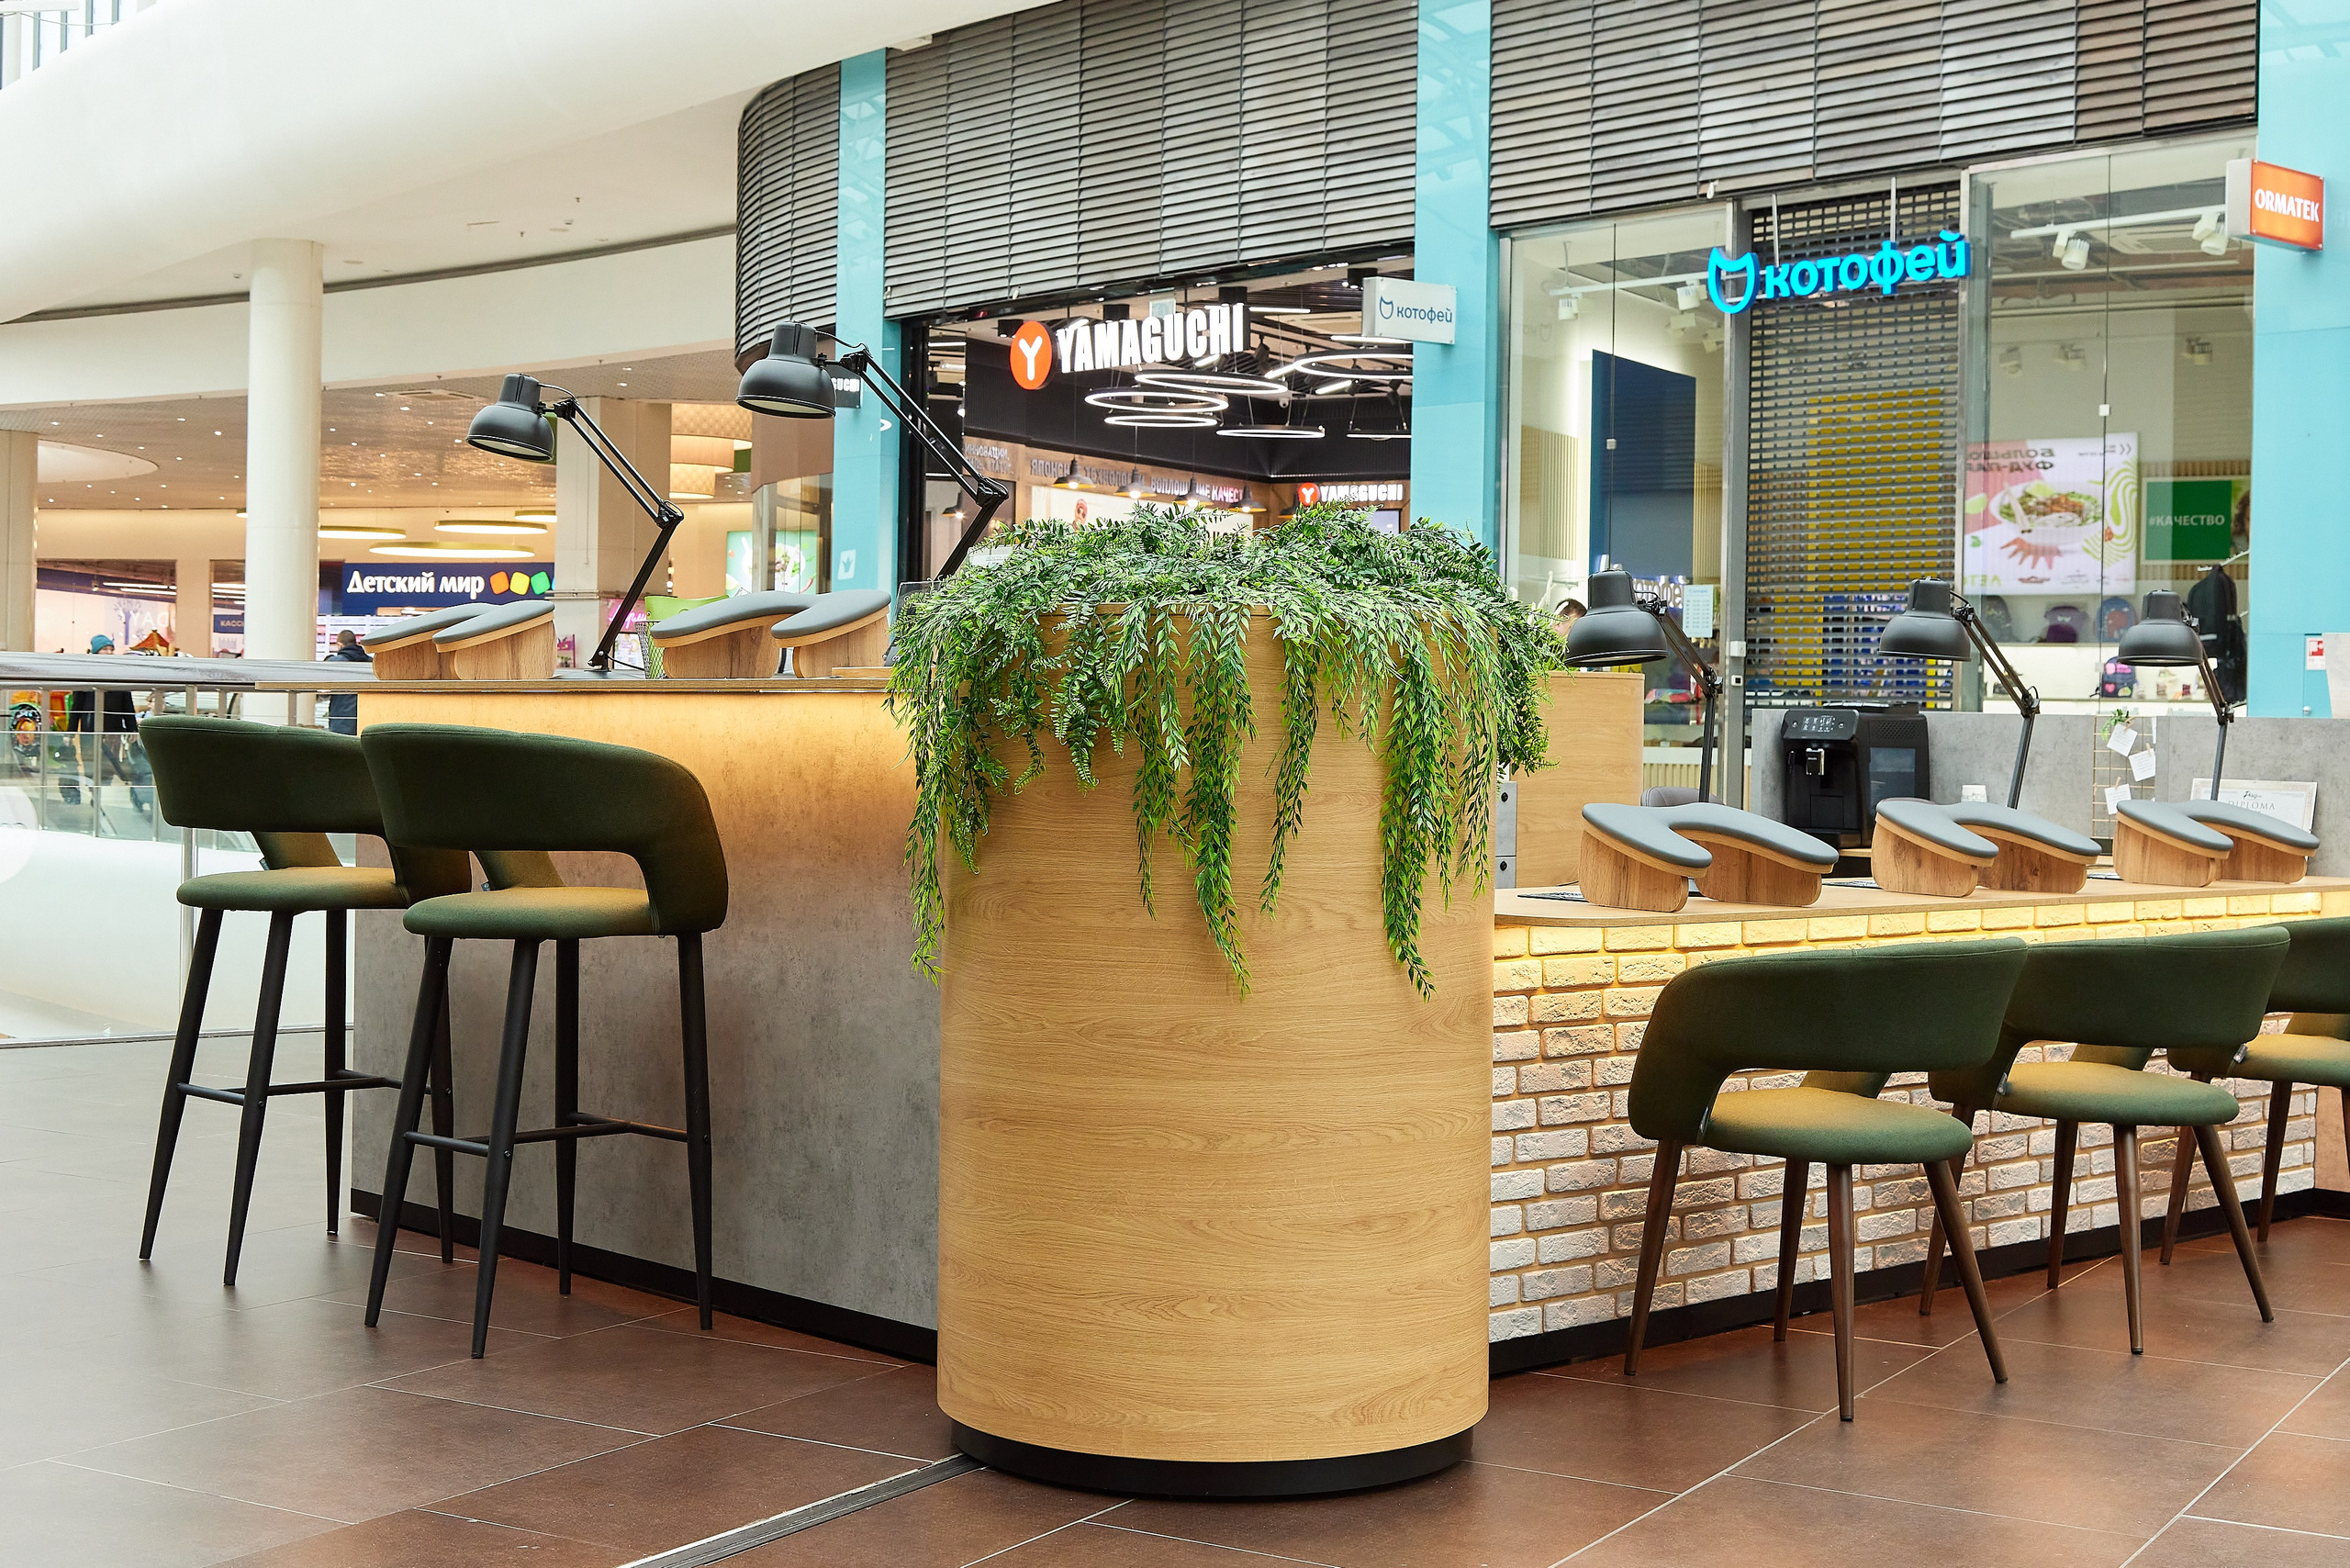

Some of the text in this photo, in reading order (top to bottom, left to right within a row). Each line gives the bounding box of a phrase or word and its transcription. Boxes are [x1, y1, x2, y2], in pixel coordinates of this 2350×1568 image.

[2255, 188, 2320, 222] ORMATEK
[1764, 230, 1970, 299] котофей
[1396, 307, 1453, 324] котофей
[1056, 303, 1245, 374] YAMAGUCHI
[2149, 514, 2225, 526] #КАЧЕСТВО
[346, 570, 486, 600] Детский мир
